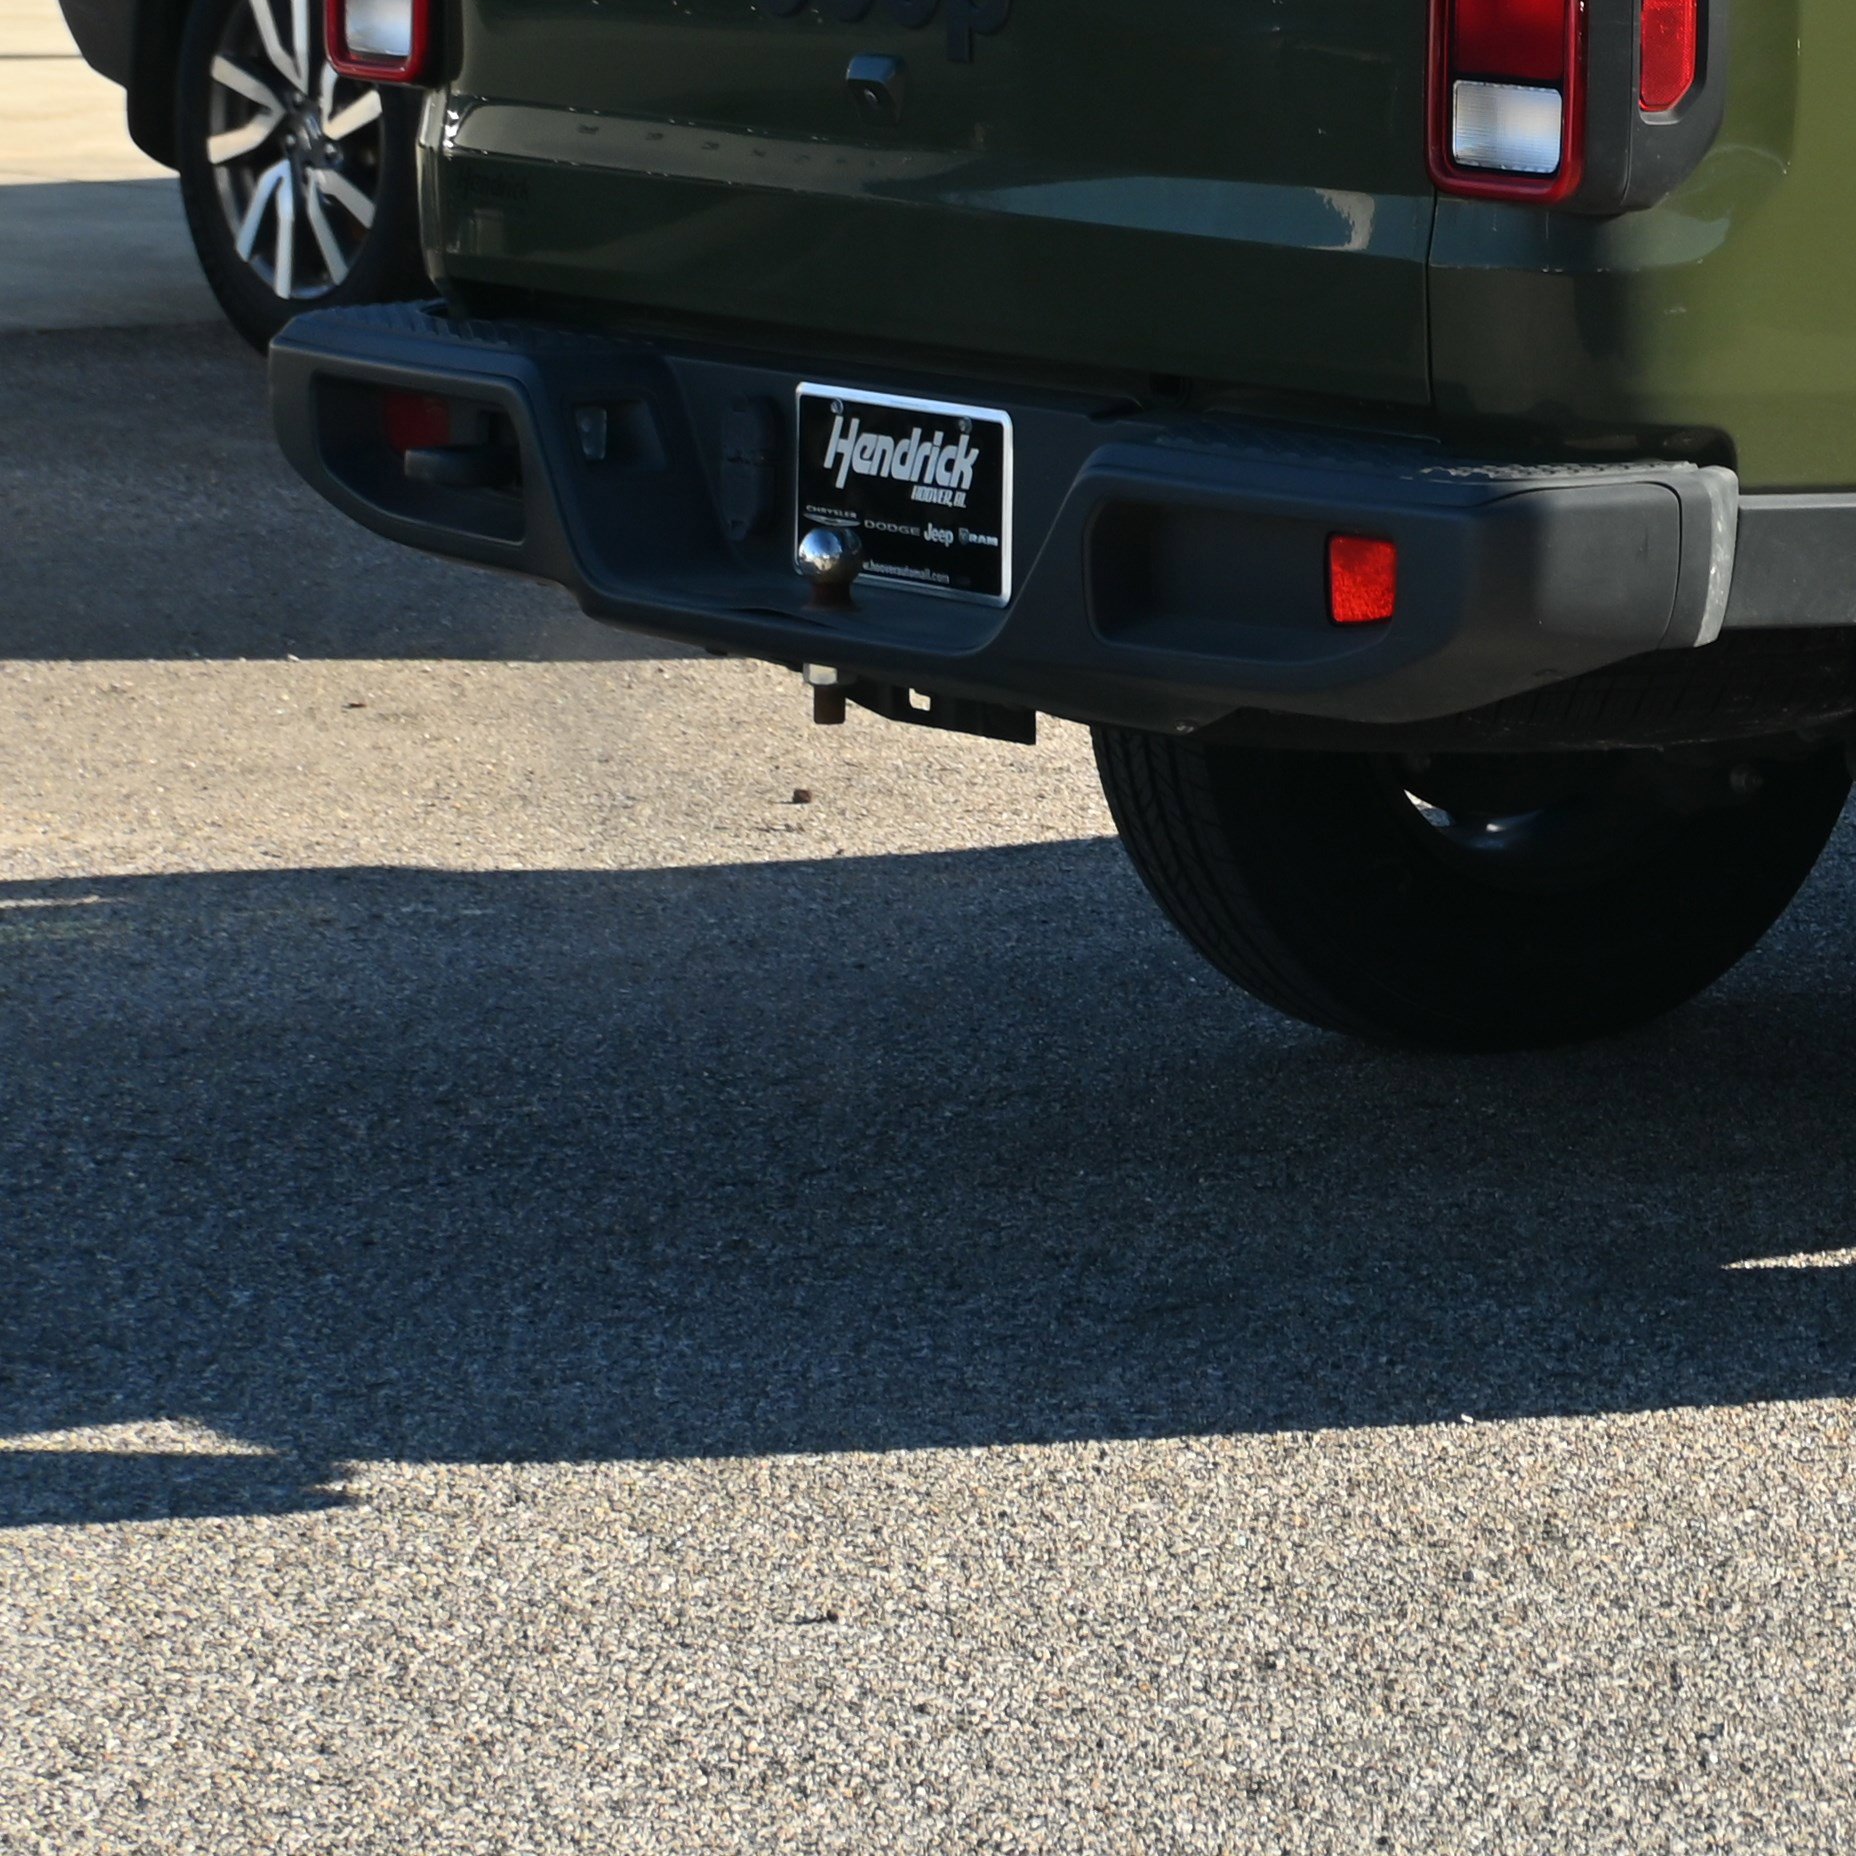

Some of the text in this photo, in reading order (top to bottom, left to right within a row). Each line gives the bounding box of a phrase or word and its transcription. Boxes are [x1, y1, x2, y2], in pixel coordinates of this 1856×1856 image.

[823, 415, 980, 490] Hendrick
[911, 485, 953, 508] HOOVER,
[806, 504, 858, 519] CHRYSLER
[864, 519, 921, 536] DODGE
[924, 522, 954, 547] Jeep
[968, 534, 998, 547] RAM
